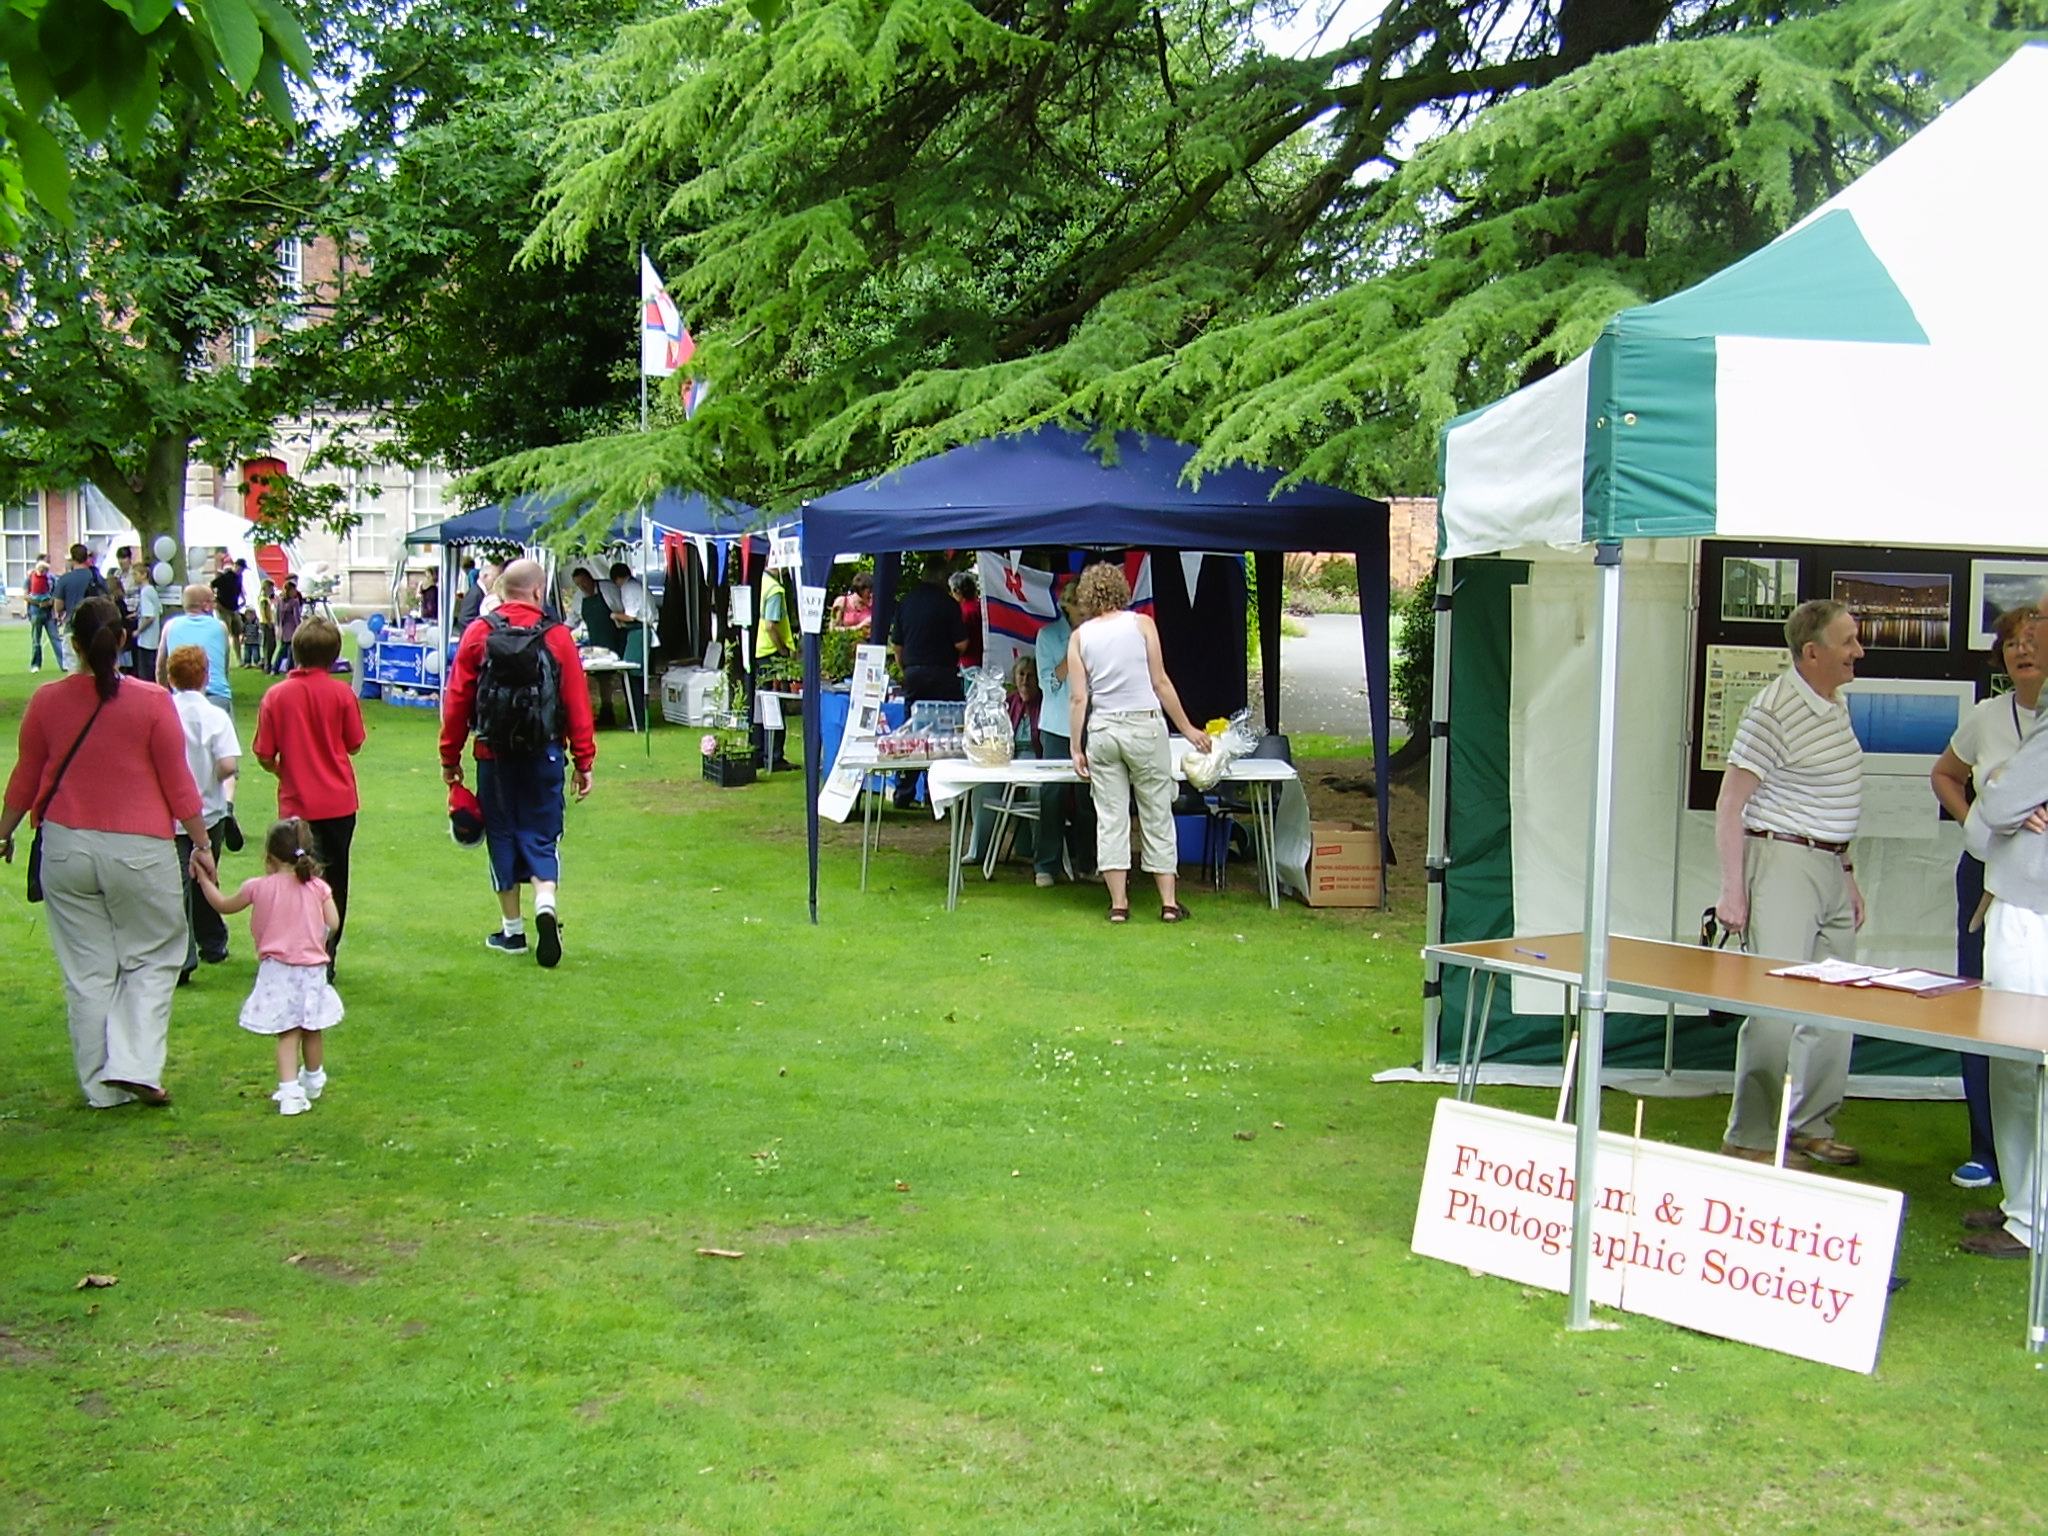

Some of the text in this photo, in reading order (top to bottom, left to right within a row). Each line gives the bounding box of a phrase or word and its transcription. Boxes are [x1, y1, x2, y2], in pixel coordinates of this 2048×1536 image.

[1452, 1144, 1862, 1266] Frodshm & District
[1701, 1249, 1854, 1323] Society
